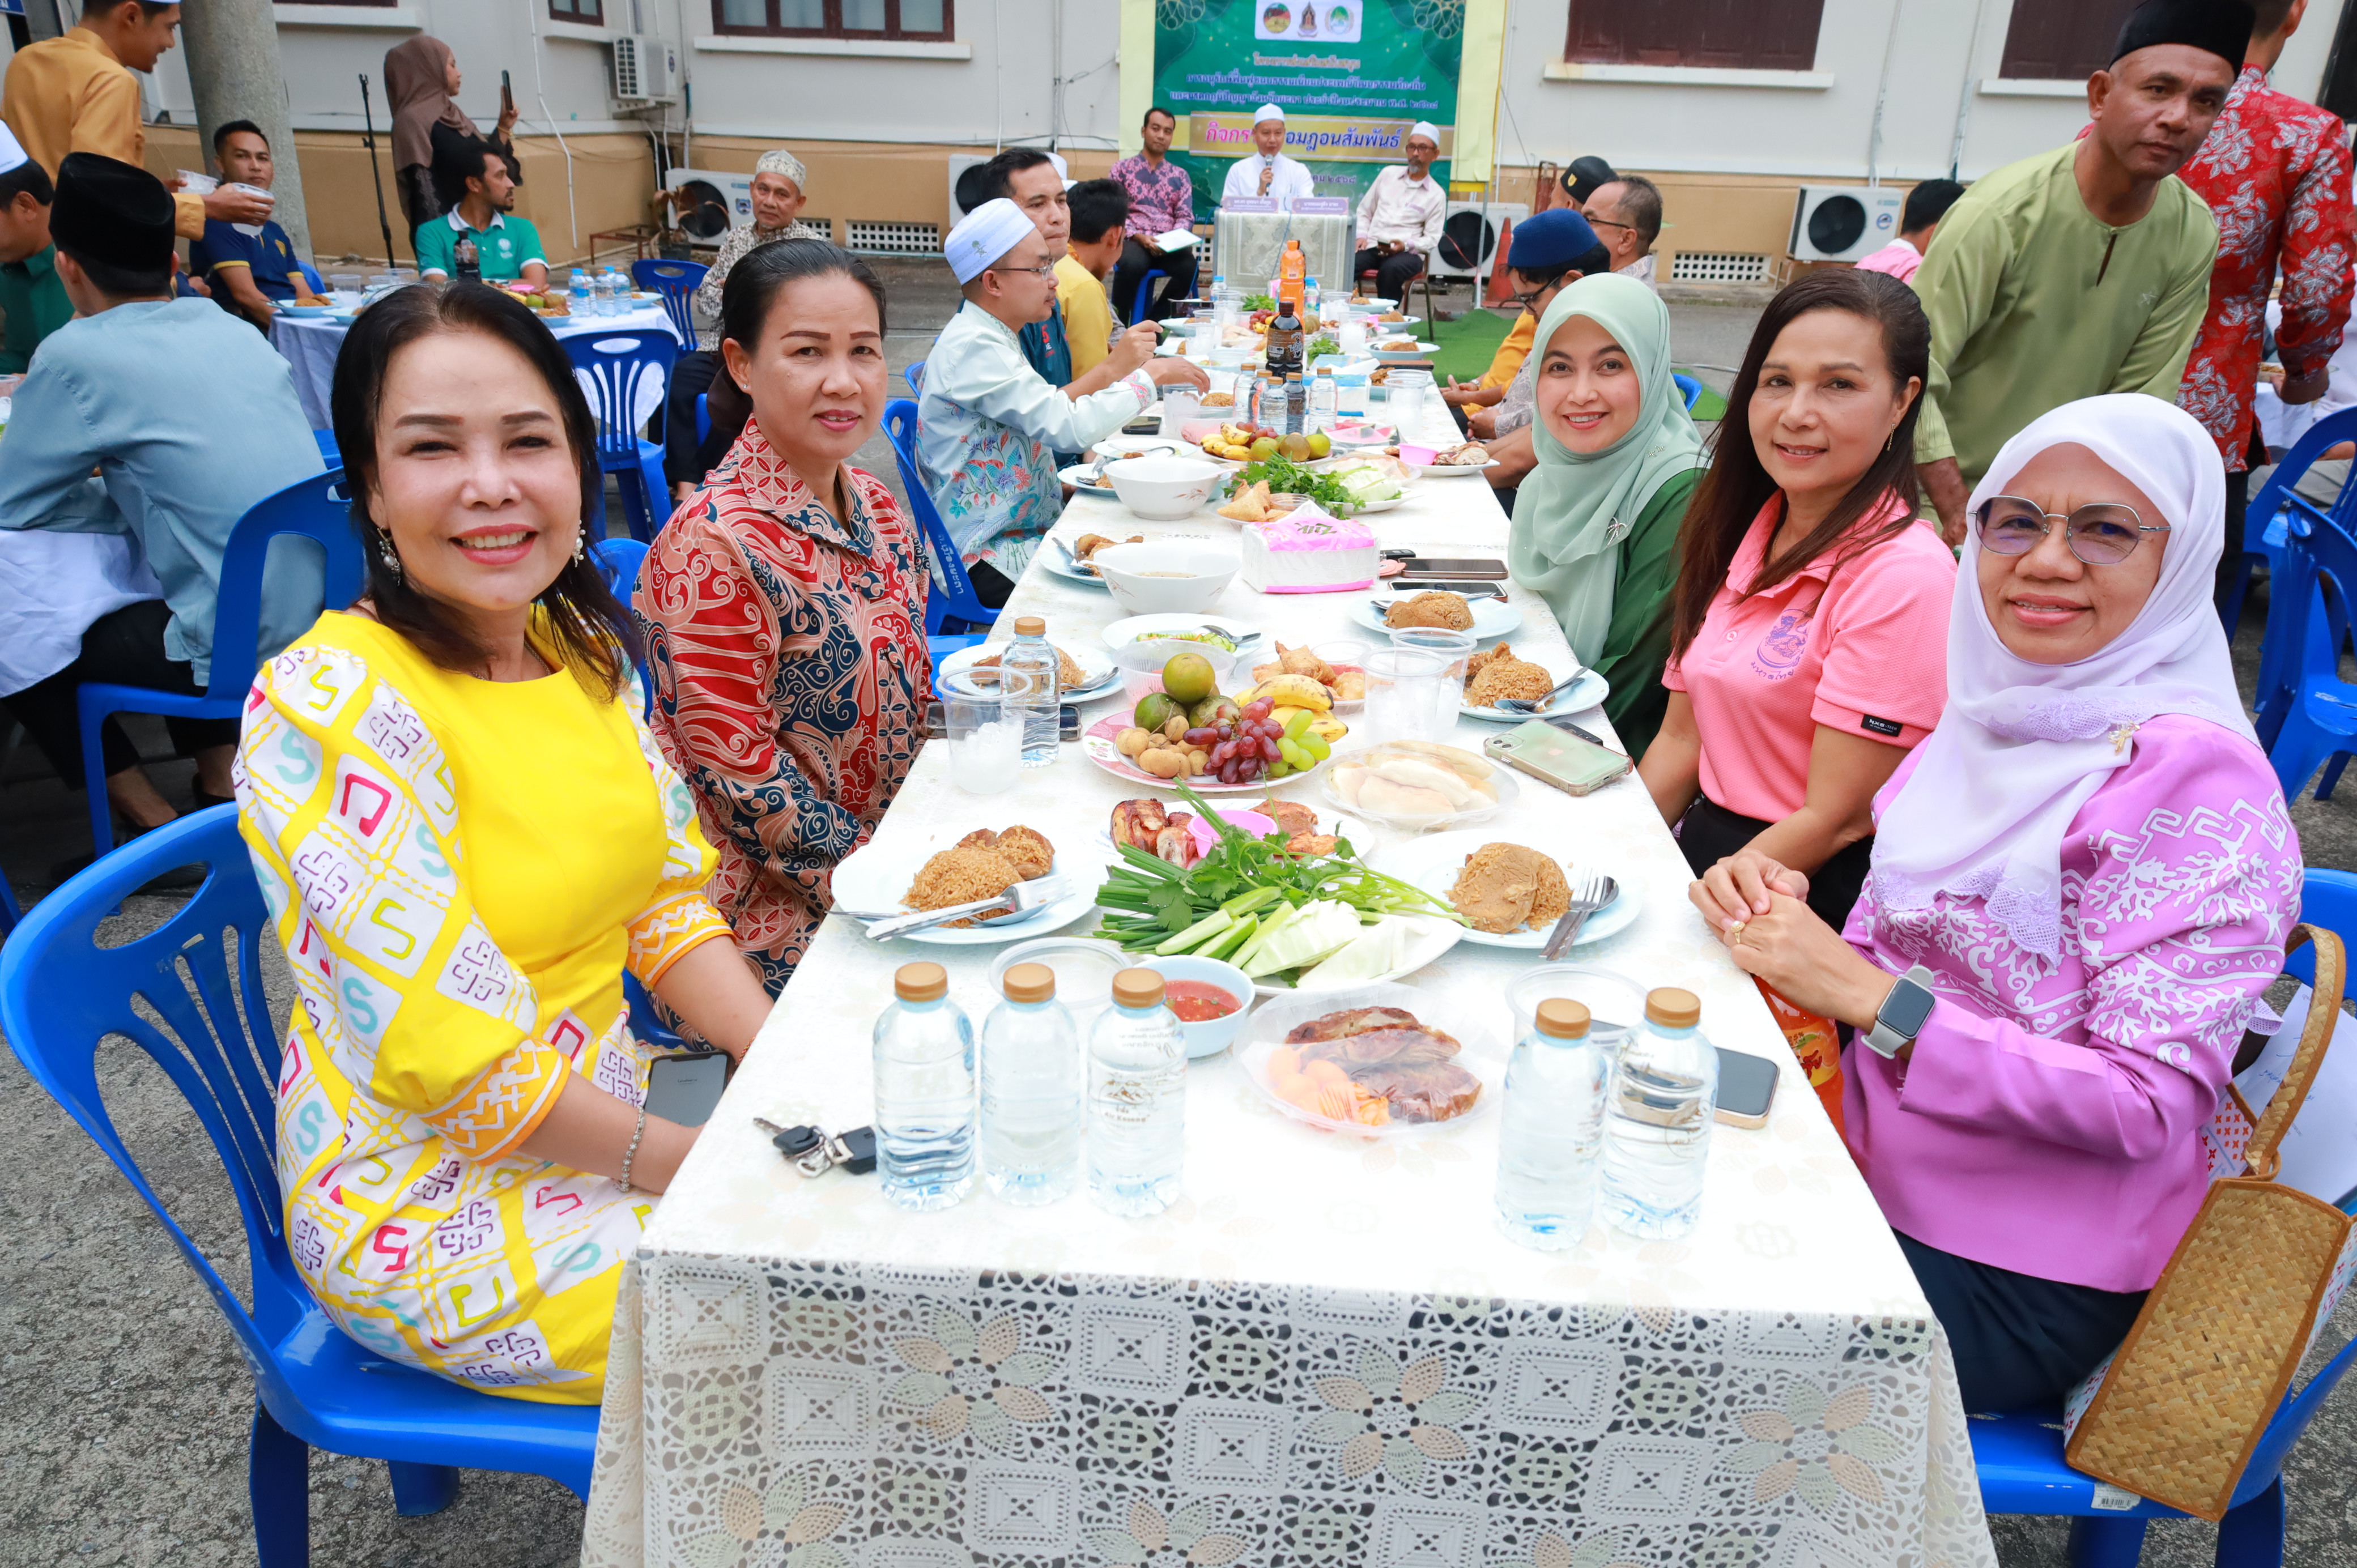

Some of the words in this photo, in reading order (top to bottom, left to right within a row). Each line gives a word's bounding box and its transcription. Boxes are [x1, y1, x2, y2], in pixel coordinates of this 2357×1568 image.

[1206, 121, 1256, 143] กิจกร
[1286, 126, 1403, 151] อมฎอนสัมพันธ์
[1751, 662, 1794, 680] มหาดไทย
